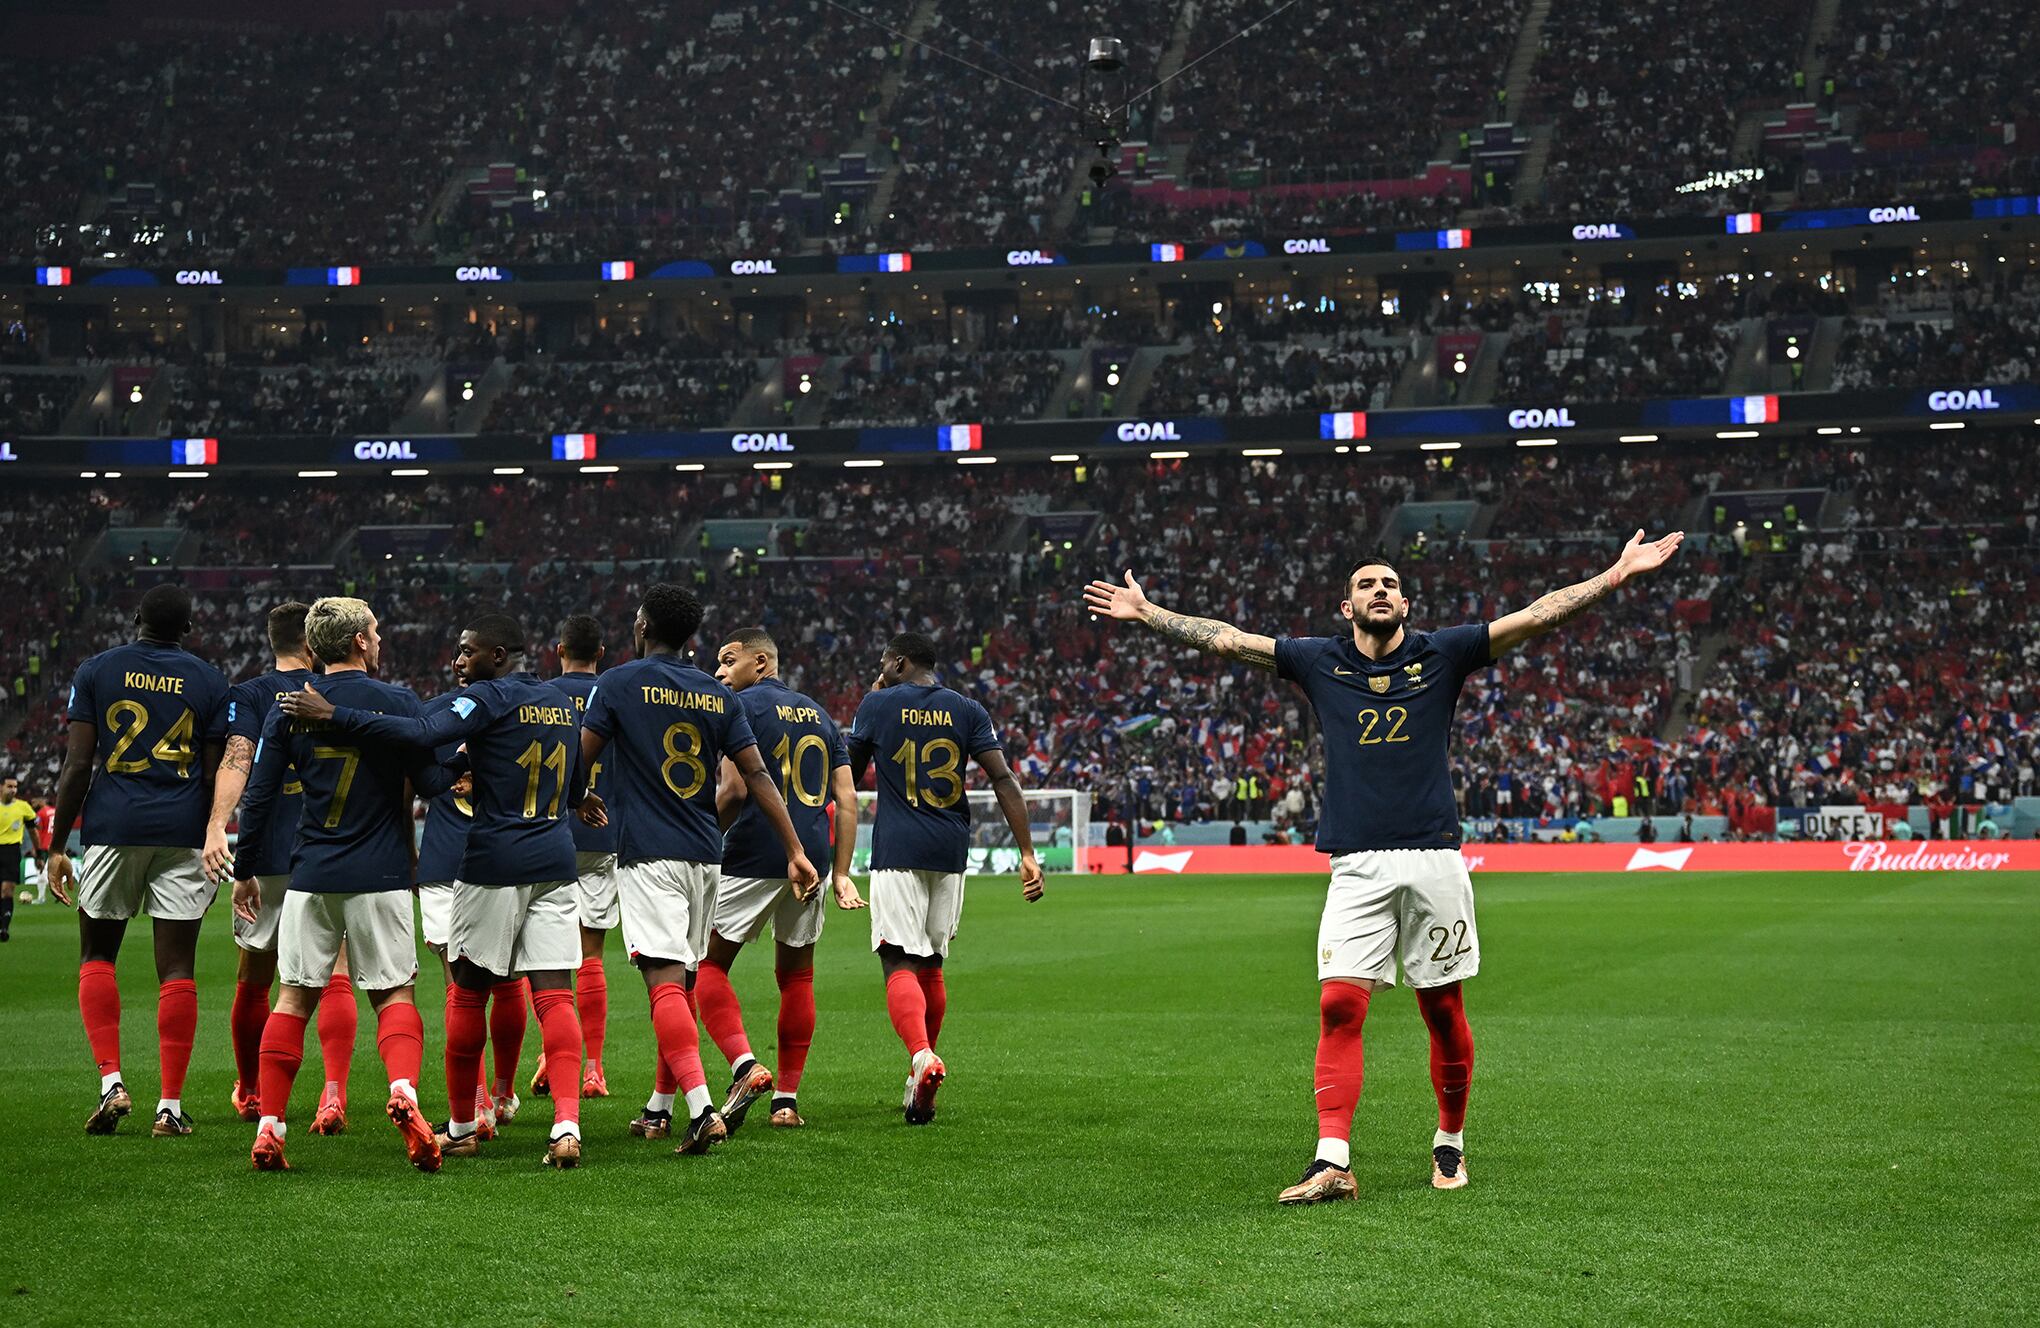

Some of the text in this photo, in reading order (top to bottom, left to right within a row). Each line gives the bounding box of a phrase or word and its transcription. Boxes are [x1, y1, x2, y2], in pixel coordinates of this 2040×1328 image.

[1869, 205, 1921, 223] GOAL
[1572, 223, 1621, 240] GOAL
[1284, 239, 1331, 254] GOAL
[176, 270, 223, 285] GOAL
[456, 266, 502, 282] GOAL
[731, 259, 777, 275] GOAL
[1928, 388, 1999, 411] GOAL
[1508, 407, 1575, 429] GOAL
[732, 433, 795, 453] GOAL
[1117, 421, 1181, 442] GOAL
[354, 440, 418, 460] GOAL
[125, 671, 184, 694] KONATE
[519, 704, 573, 727] DEMBELE
[901, 708, 953, 726] FOFANA
[1358, 706, 1410, 745] 22
[105, 699, 196, 779] 24
[661, 722, 707, 800] 8
[772, 732, 829, 807] 10
[515, 739, 567, 820] 11
[891, 738, 963, 809] 13
[313, 746, 362, 828] 7
[1842, 840, 2010, 872] Budweiser
[1428, 919, 1472, 962] 22
